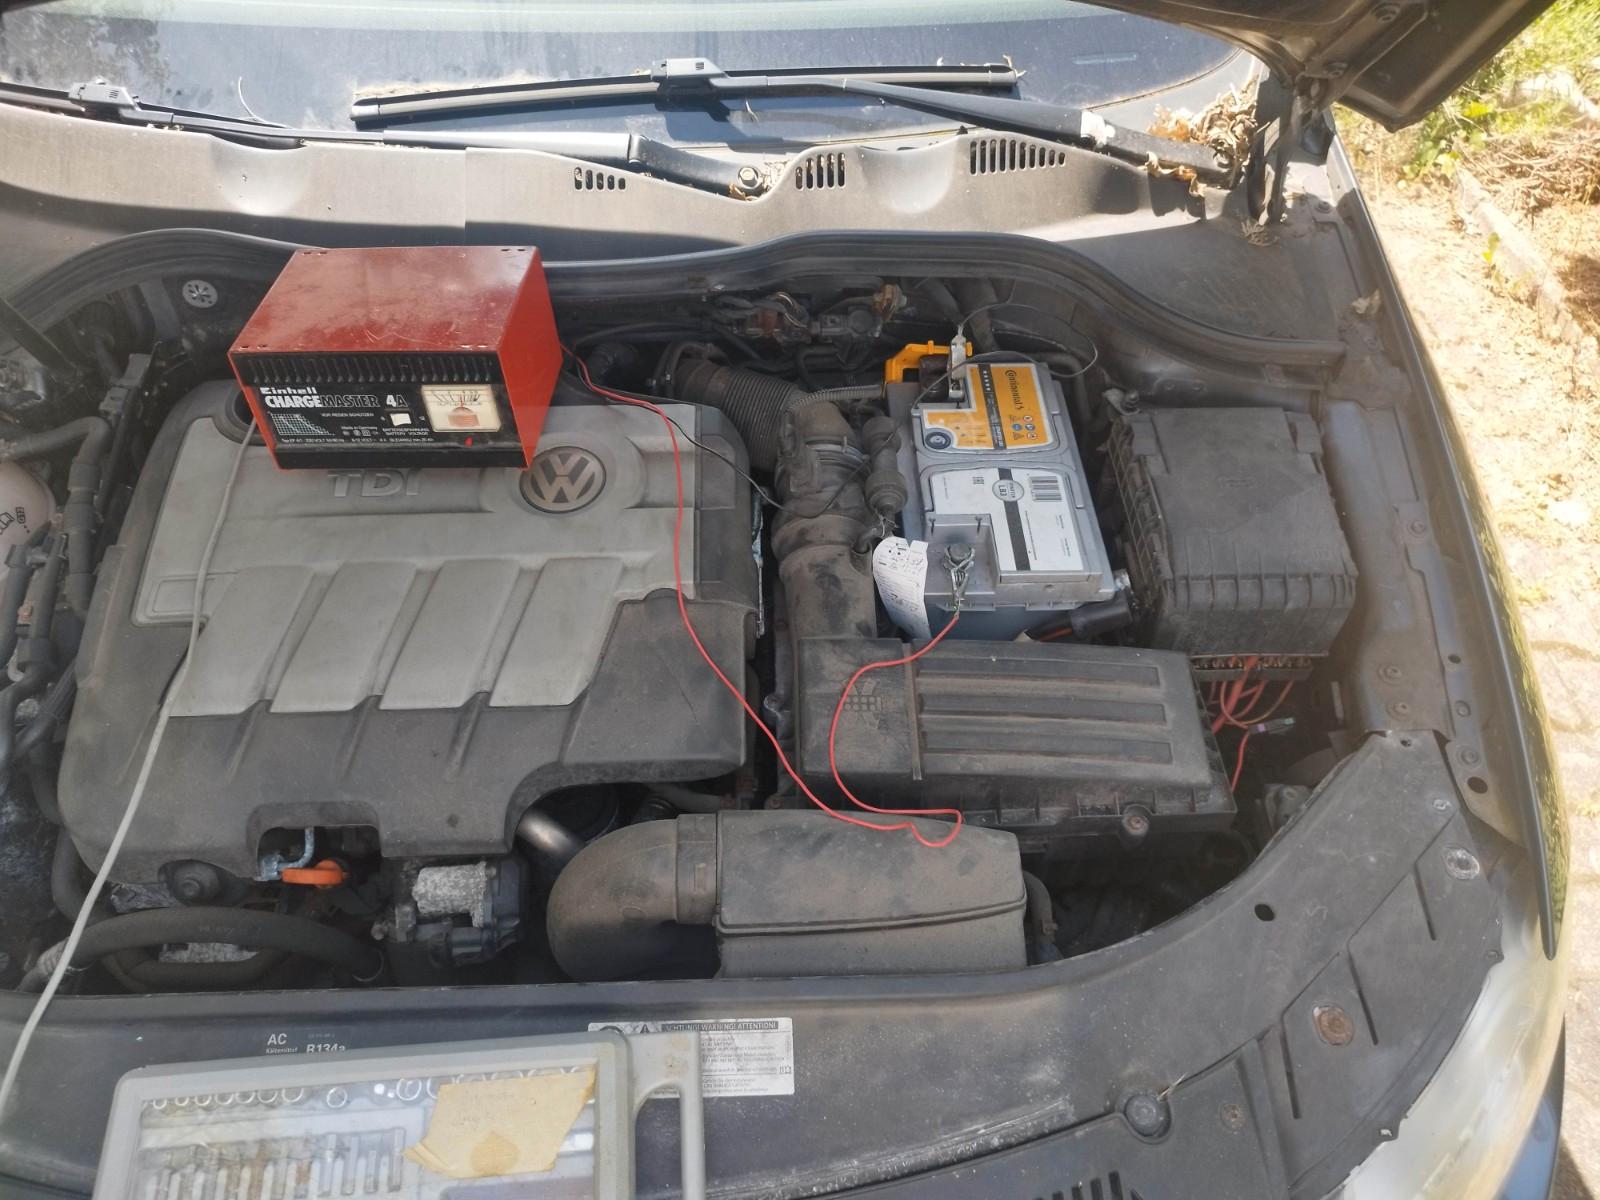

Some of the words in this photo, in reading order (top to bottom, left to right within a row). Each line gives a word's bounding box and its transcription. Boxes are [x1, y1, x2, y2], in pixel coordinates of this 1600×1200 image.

[1005, 370, 1023, 405] Continental
[265, 395, 381, 408] CHARGEMASTER
[386, 394, 409, 408] 4A
[328, 471, 420, 497] TDI
[267, 1033, 287, 1045] AC
